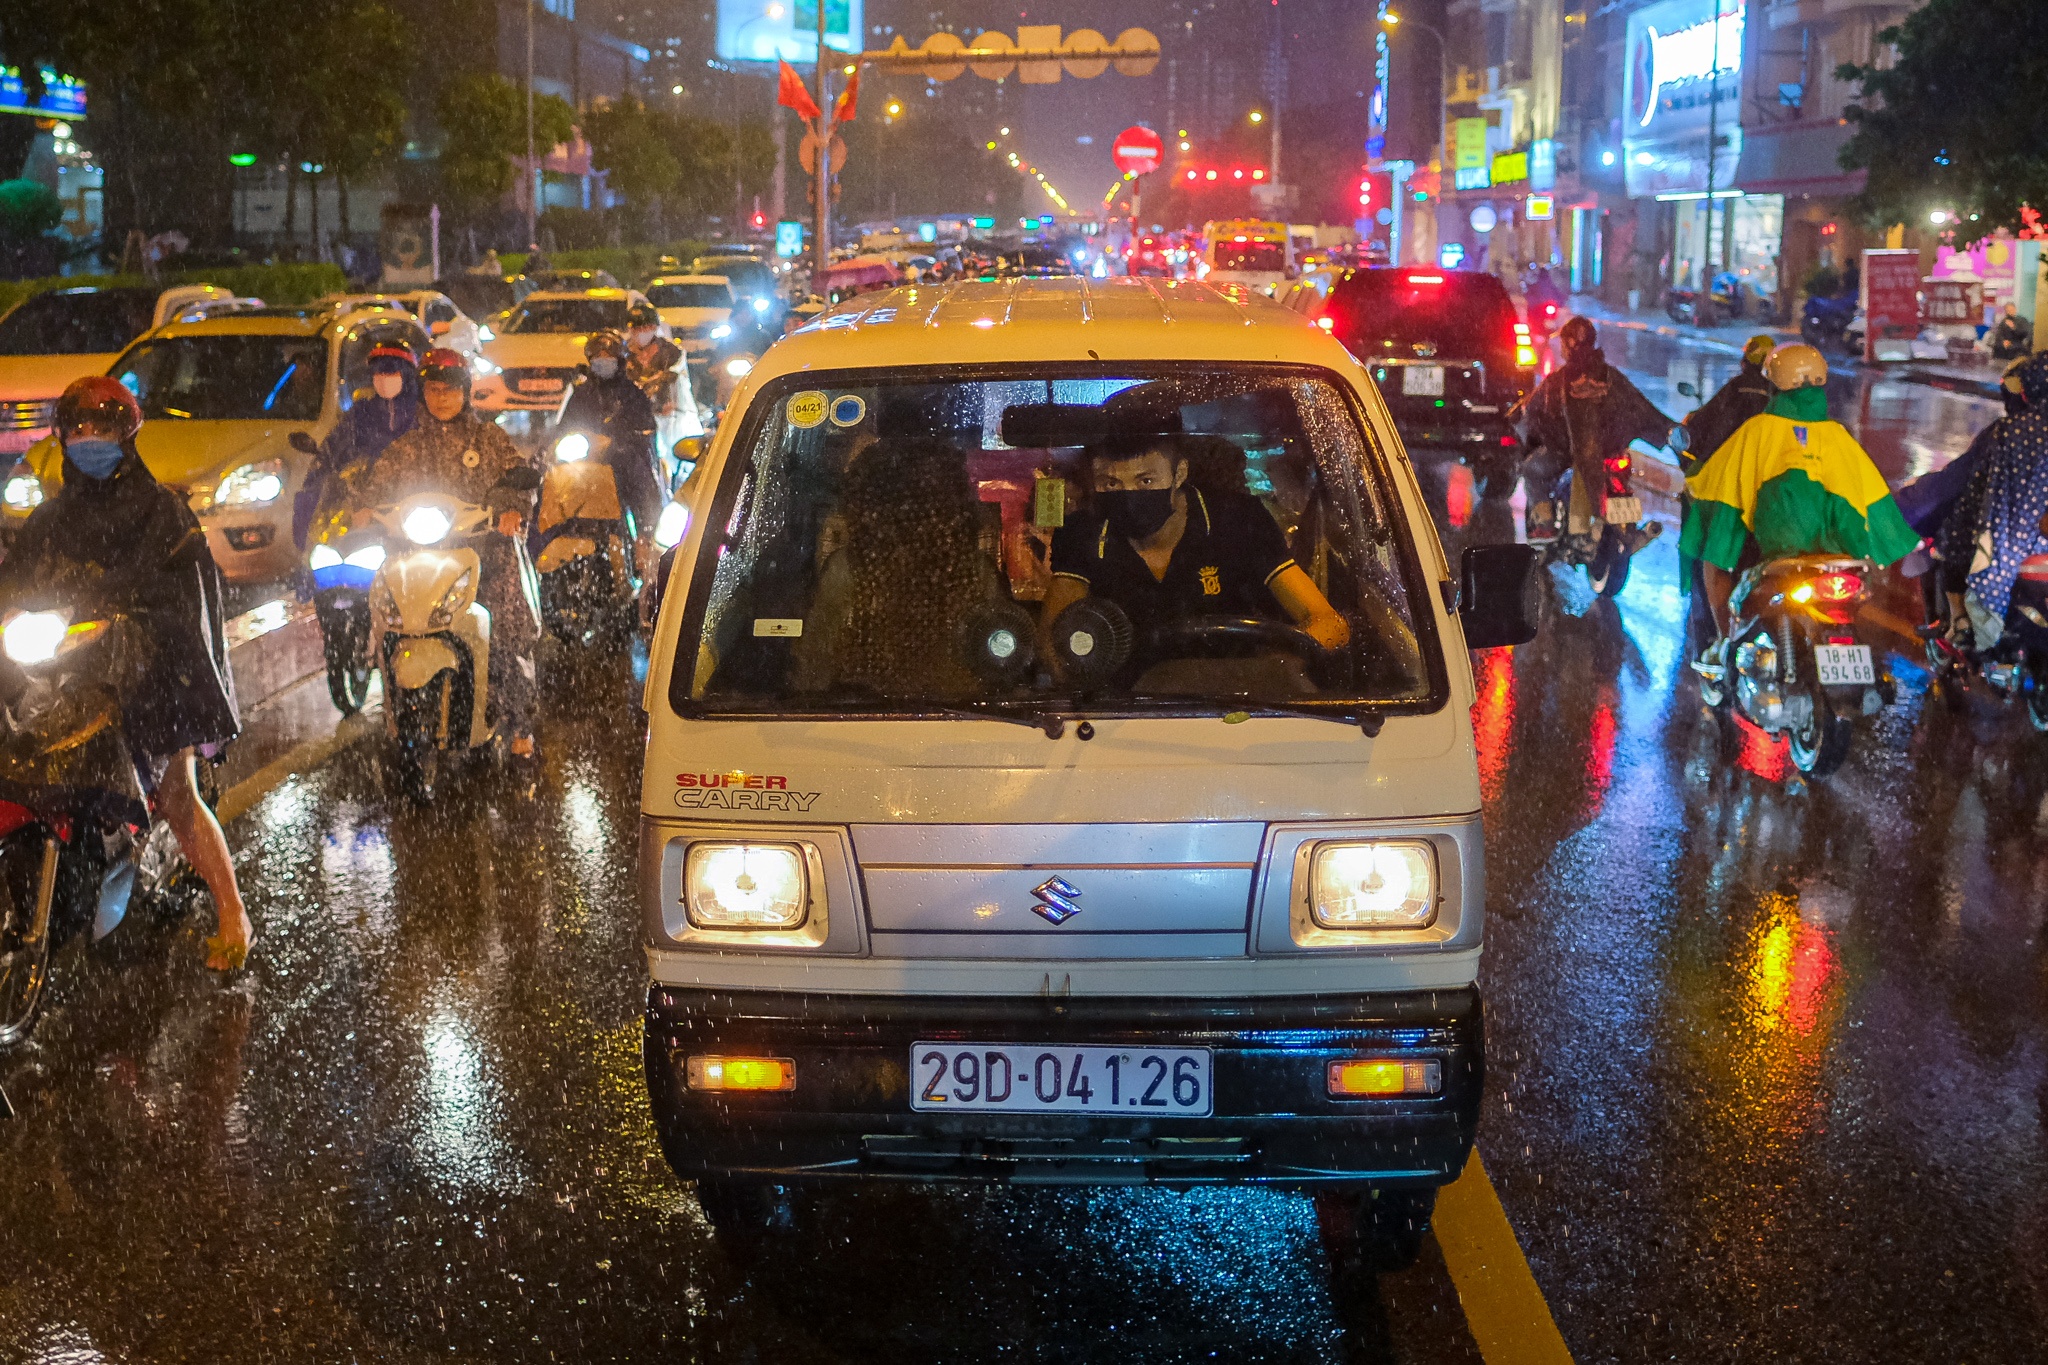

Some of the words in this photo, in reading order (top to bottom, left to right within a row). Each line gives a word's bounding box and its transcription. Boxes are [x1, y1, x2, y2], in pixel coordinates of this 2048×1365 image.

[796, 402, 821, 413] 04/21
[1825, 649, 1863, 663] 18-H1
[675, 773, 788, 790] SUPER
[674, 788, 821, 812] CARRY
[920, 1051, 1201, 1107] 29D-041.26
